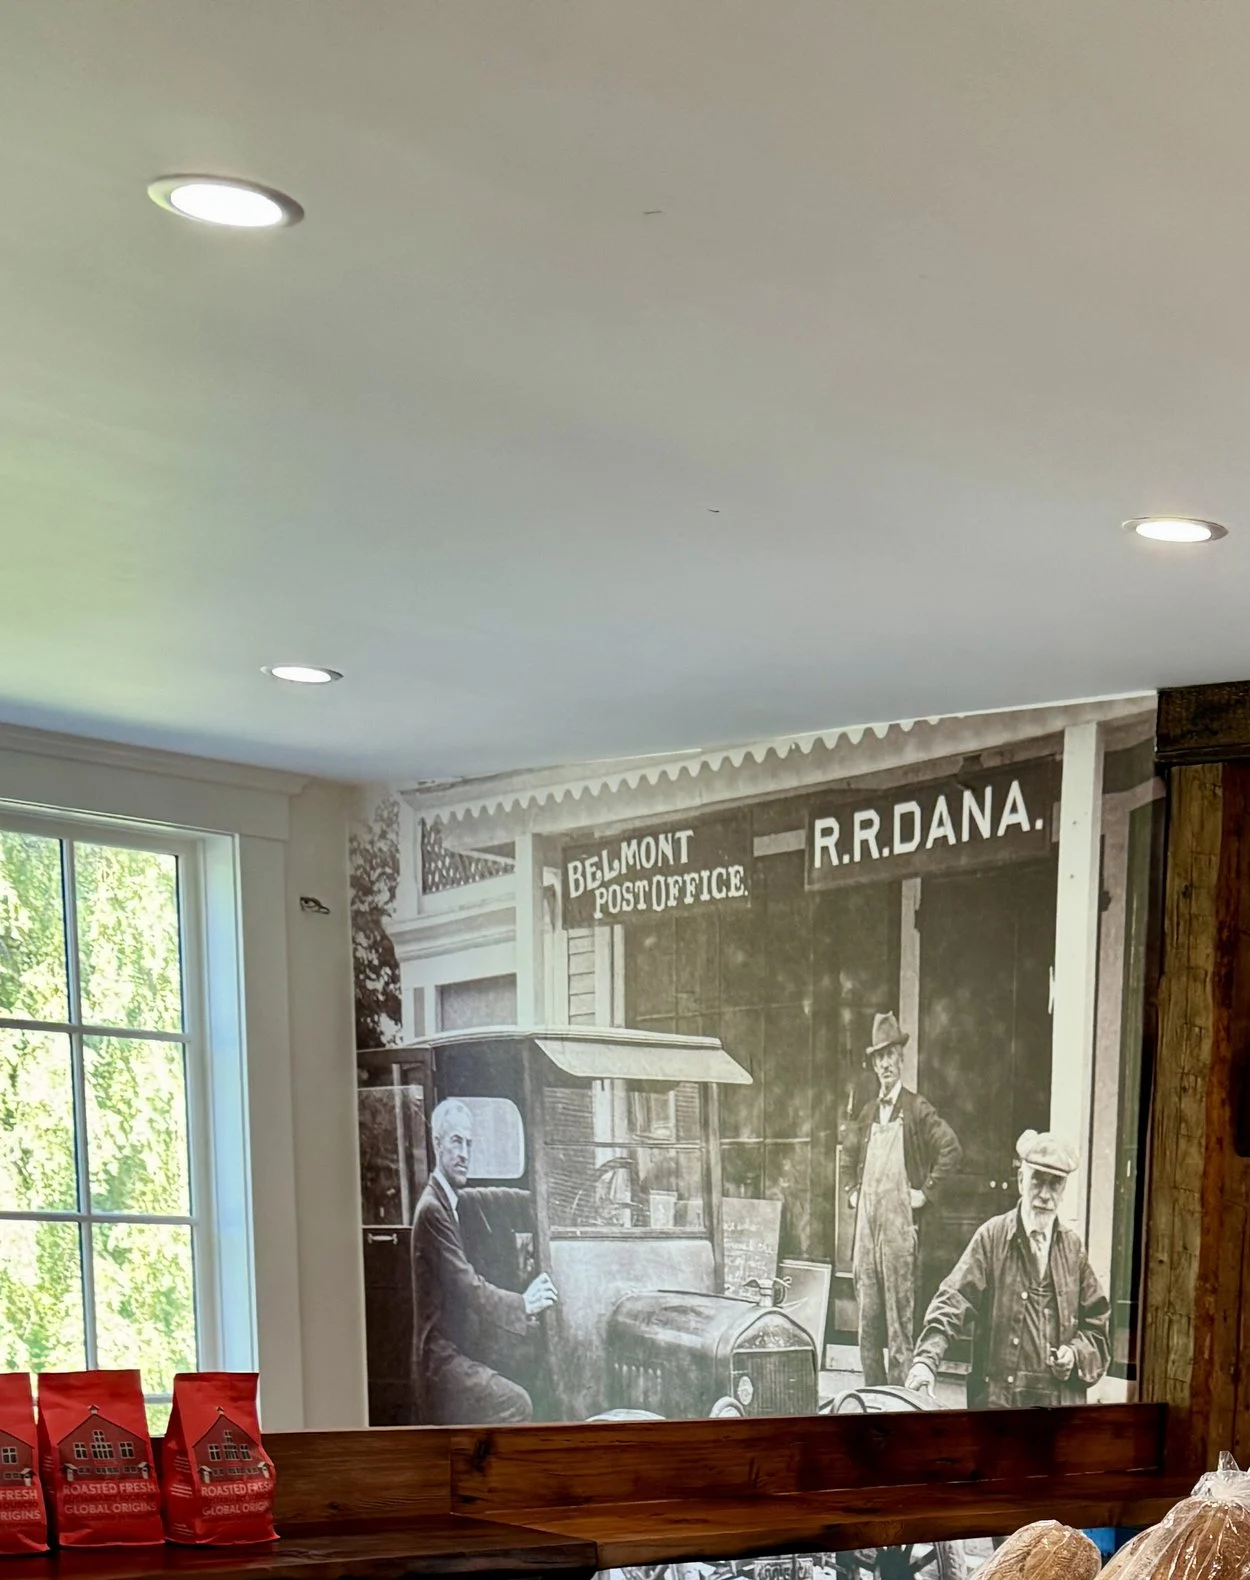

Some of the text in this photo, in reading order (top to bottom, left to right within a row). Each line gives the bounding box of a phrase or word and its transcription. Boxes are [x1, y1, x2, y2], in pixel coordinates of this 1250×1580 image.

[567, 829, 694, 898] BELMONT
[0, 1489, 38, 1501] FRESH
[62, 1481, 157, 1496] ROASTED FRESH
[201, 1483, 245, 1497] ROASTED
[64, 1501, 157, 1515] GLOBAL ORIGINS
[202, 1504, 240, 1516] GLOBAL
[0, 1510, 41, 1521] RIGINS
